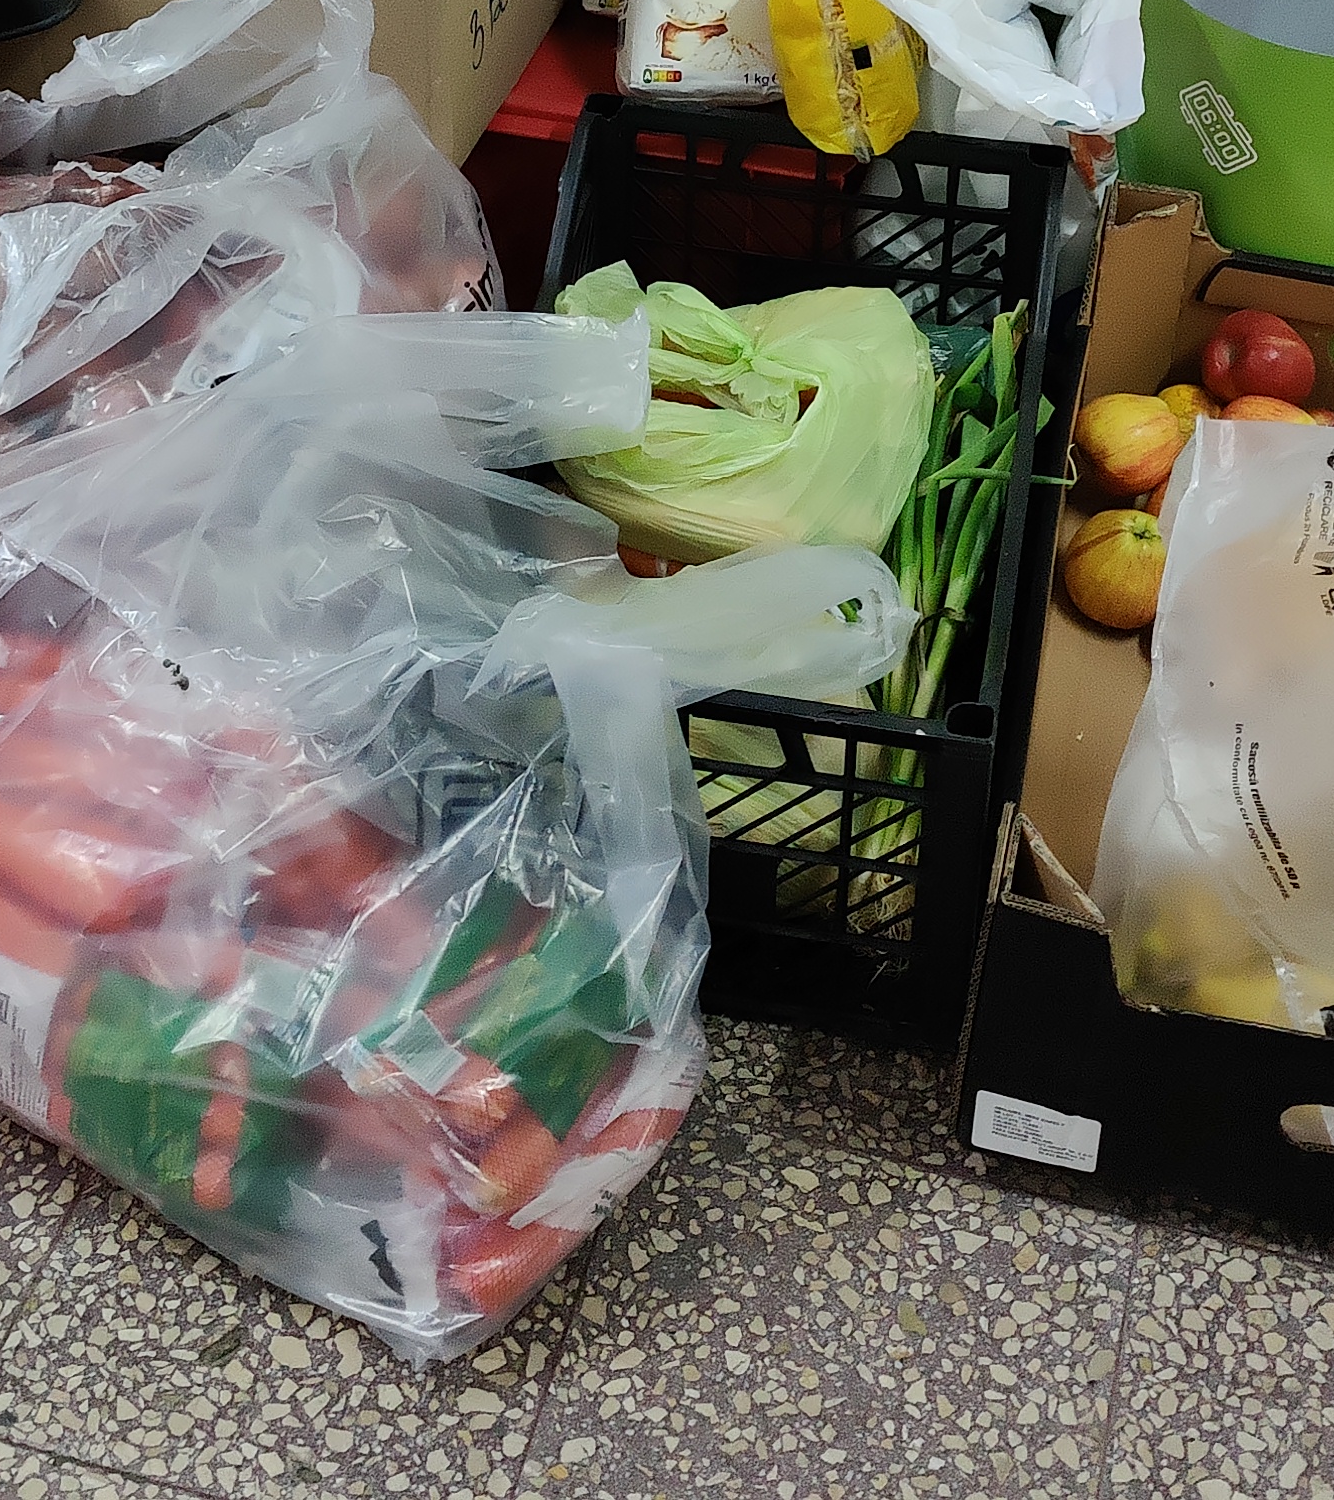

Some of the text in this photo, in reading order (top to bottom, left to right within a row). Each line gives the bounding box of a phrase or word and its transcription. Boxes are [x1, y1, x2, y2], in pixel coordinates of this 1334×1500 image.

[743, 73, 749, 84] 1
[1318, 480, 1333, 541] RECICLARE
[1239, 806, 1250, 820] cu
[1284, 866, 1298, 881] 50
